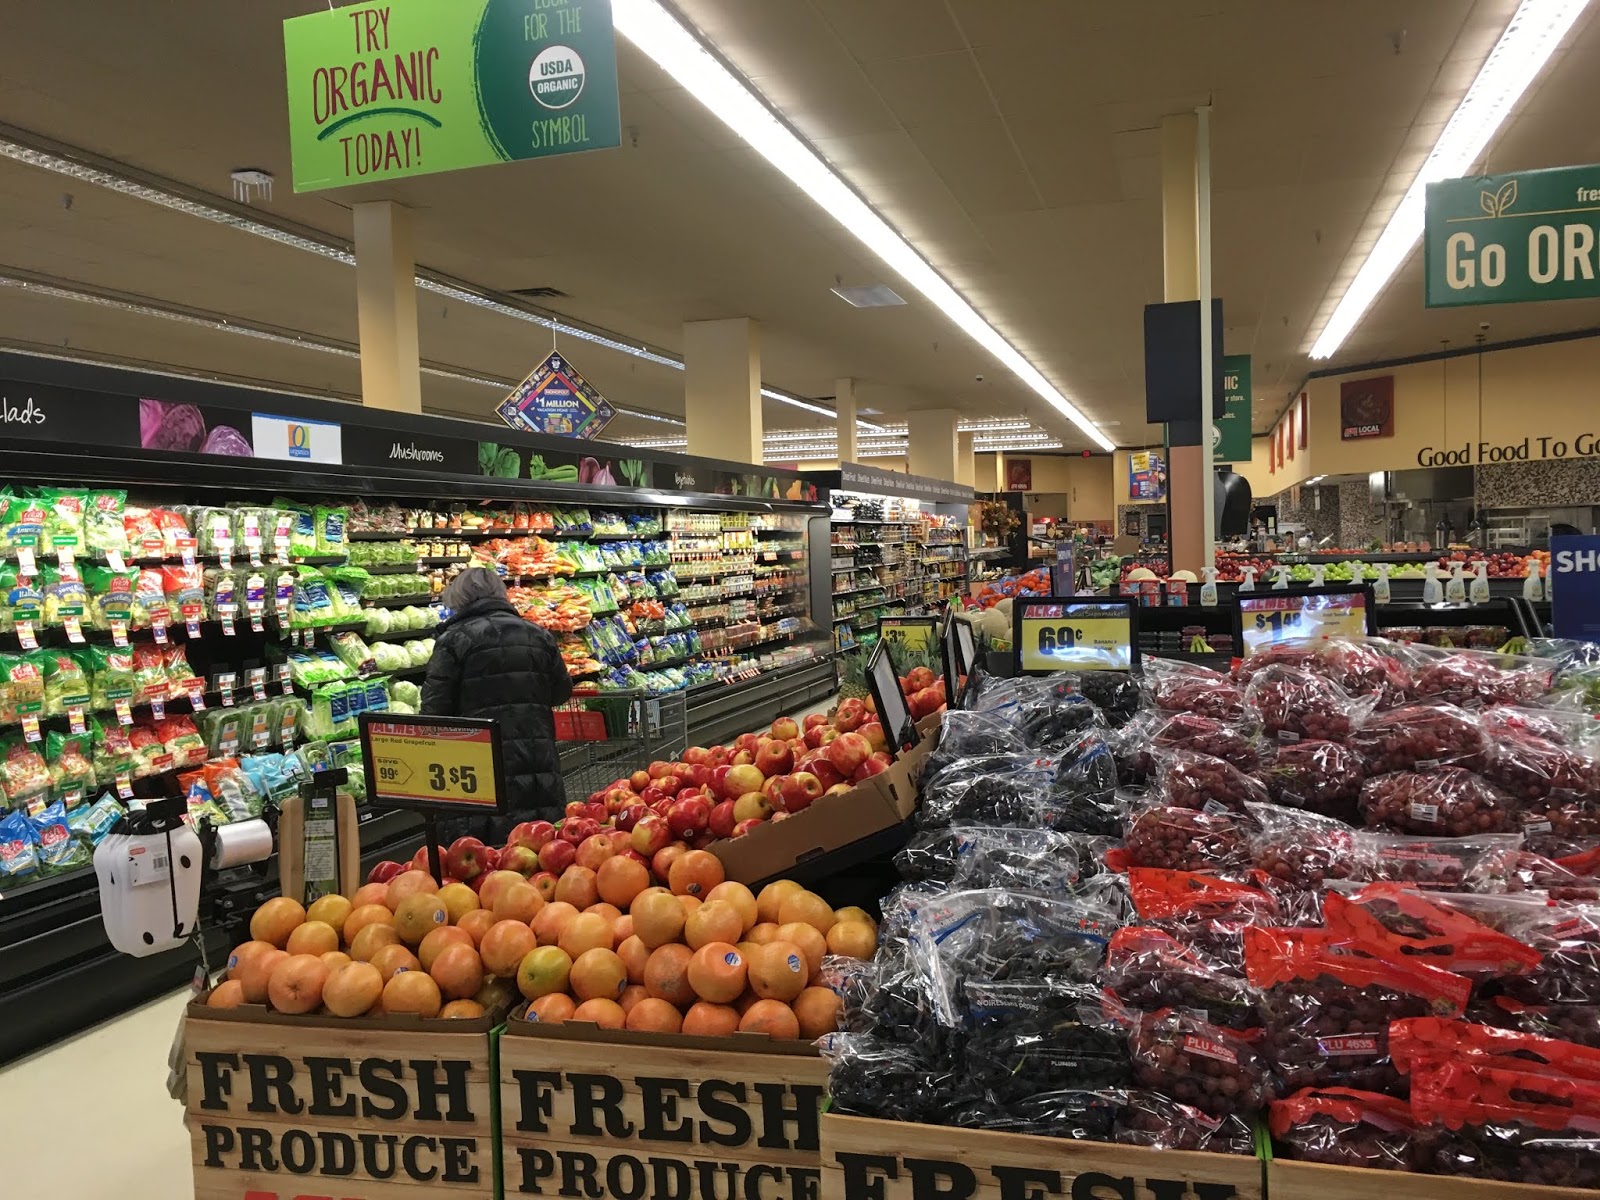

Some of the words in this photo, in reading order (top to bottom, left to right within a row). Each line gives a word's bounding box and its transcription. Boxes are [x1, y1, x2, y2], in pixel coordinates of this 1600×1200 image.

[349, 7, 391, 54] TRY
[524, 13, 548, 41] FOR
[556, 7, 582, 35] THE
[540, 58, 573, 76] USDA
[313, 47, 442, 125] ORGANIC
[537, 77, 579, 95] ORGANIC
[531, 114, 590, 148] SYMBOL
[339, 127, 421, 177] TODAY!
[1446, 232, 1506, 290] Go
[1528, 224, 1600, 284] OR
[0, 397, 46, 425] lads
[546, 400, 580, 409] MILLION
[1358, 425, 1380, 433] LOCAL
[389, 442, 444, 463] Mushrooms
[1417, 442, 1470, 467] Good
[1478, 437, 1529, 462] Food
[1536, 436, 1567, 458] To
[1556, 549, 1600, 573] SH
[1187, 1038, 1209, 1051] PLU
[1322, 1039, 1343, 1050] PLU
[1346, 1038, 1373, 1049] 4635
[195, 1051, 475, 1123] FRESH
[512, 1069, 823, 1151] FRESH
[201, 1124, 479, 1183] PRODUCE
